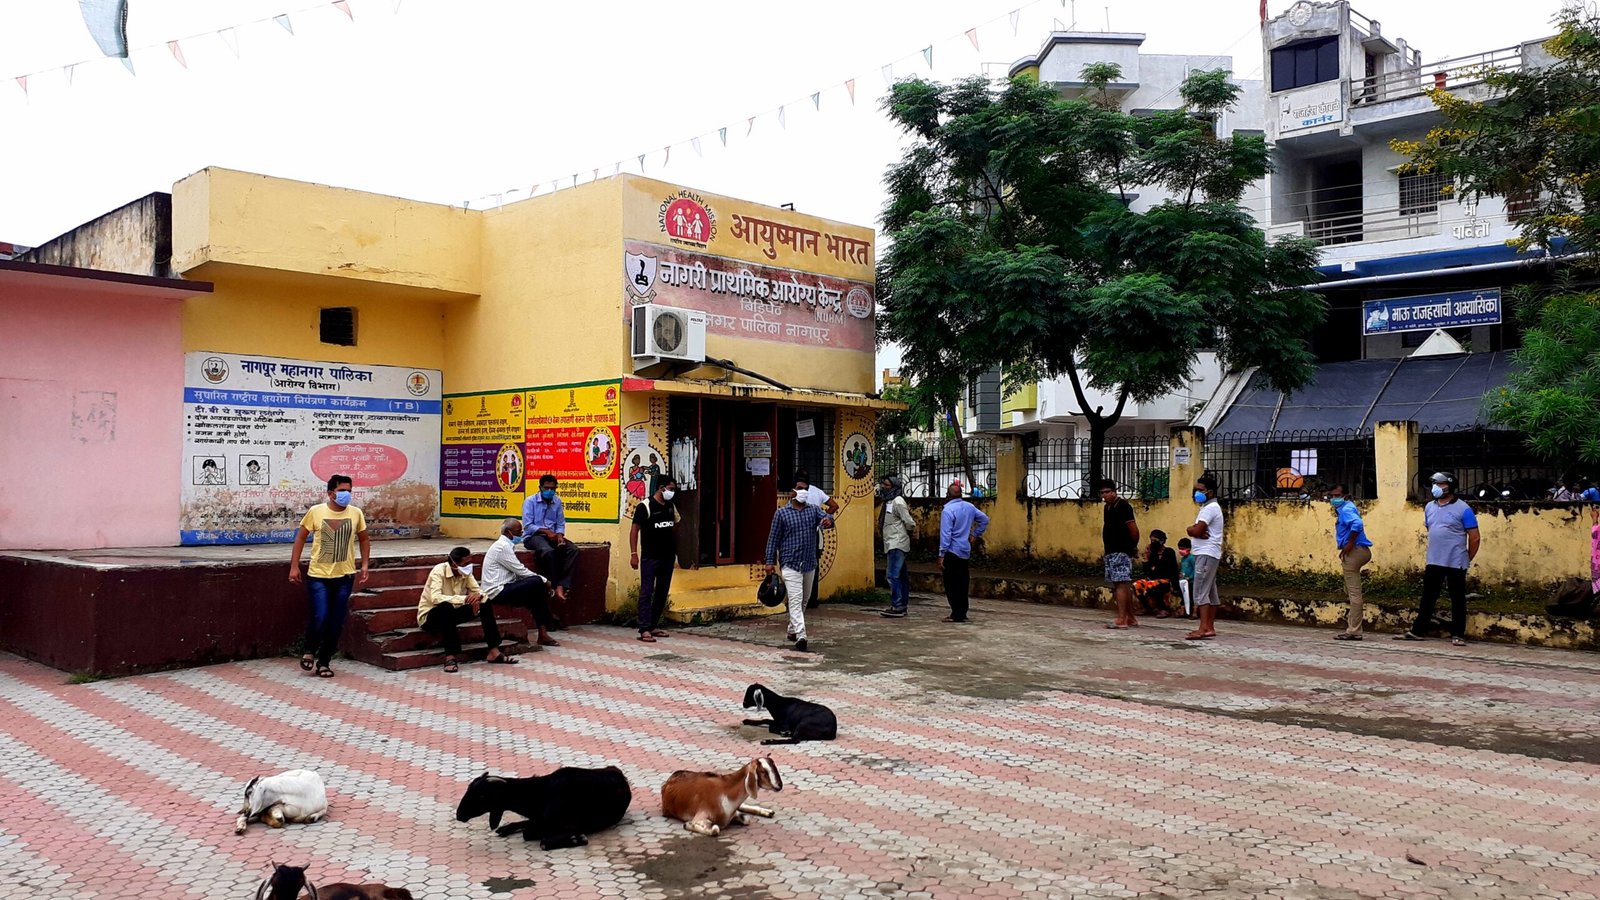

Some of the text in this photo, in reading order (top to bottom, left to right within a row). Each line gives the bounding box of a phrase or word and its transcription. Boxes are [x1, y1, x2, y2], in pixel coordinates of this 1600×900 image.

[658, 190, 717, 242] NATIONAL HEALTH MISSION
[730, 213, 871, 265] आयुष्मान भारत
[660, 260, 706, 290] नागरी
[709, 268, 770, 298] प्राथमिक
[771, 273, 817, 306] आरोग्य
[818, 281, 843, 313] केन्द्र
[1391, 294, 1497, 321] भाऊ राजहंसाची अभ्यासिका
[740, 313, 780, 335] पालिका
[786, 322, 830, 344] नागपूर
[240, 360, 373, 382] नागपूर महानगर पालिका
[270, 378, 341, 391] (आरोग्य विभाग)
[194, 390, 367, 408] सुधारित राष्ट्रीय क्षयरोग नियंत्रण कार्यक्रम
